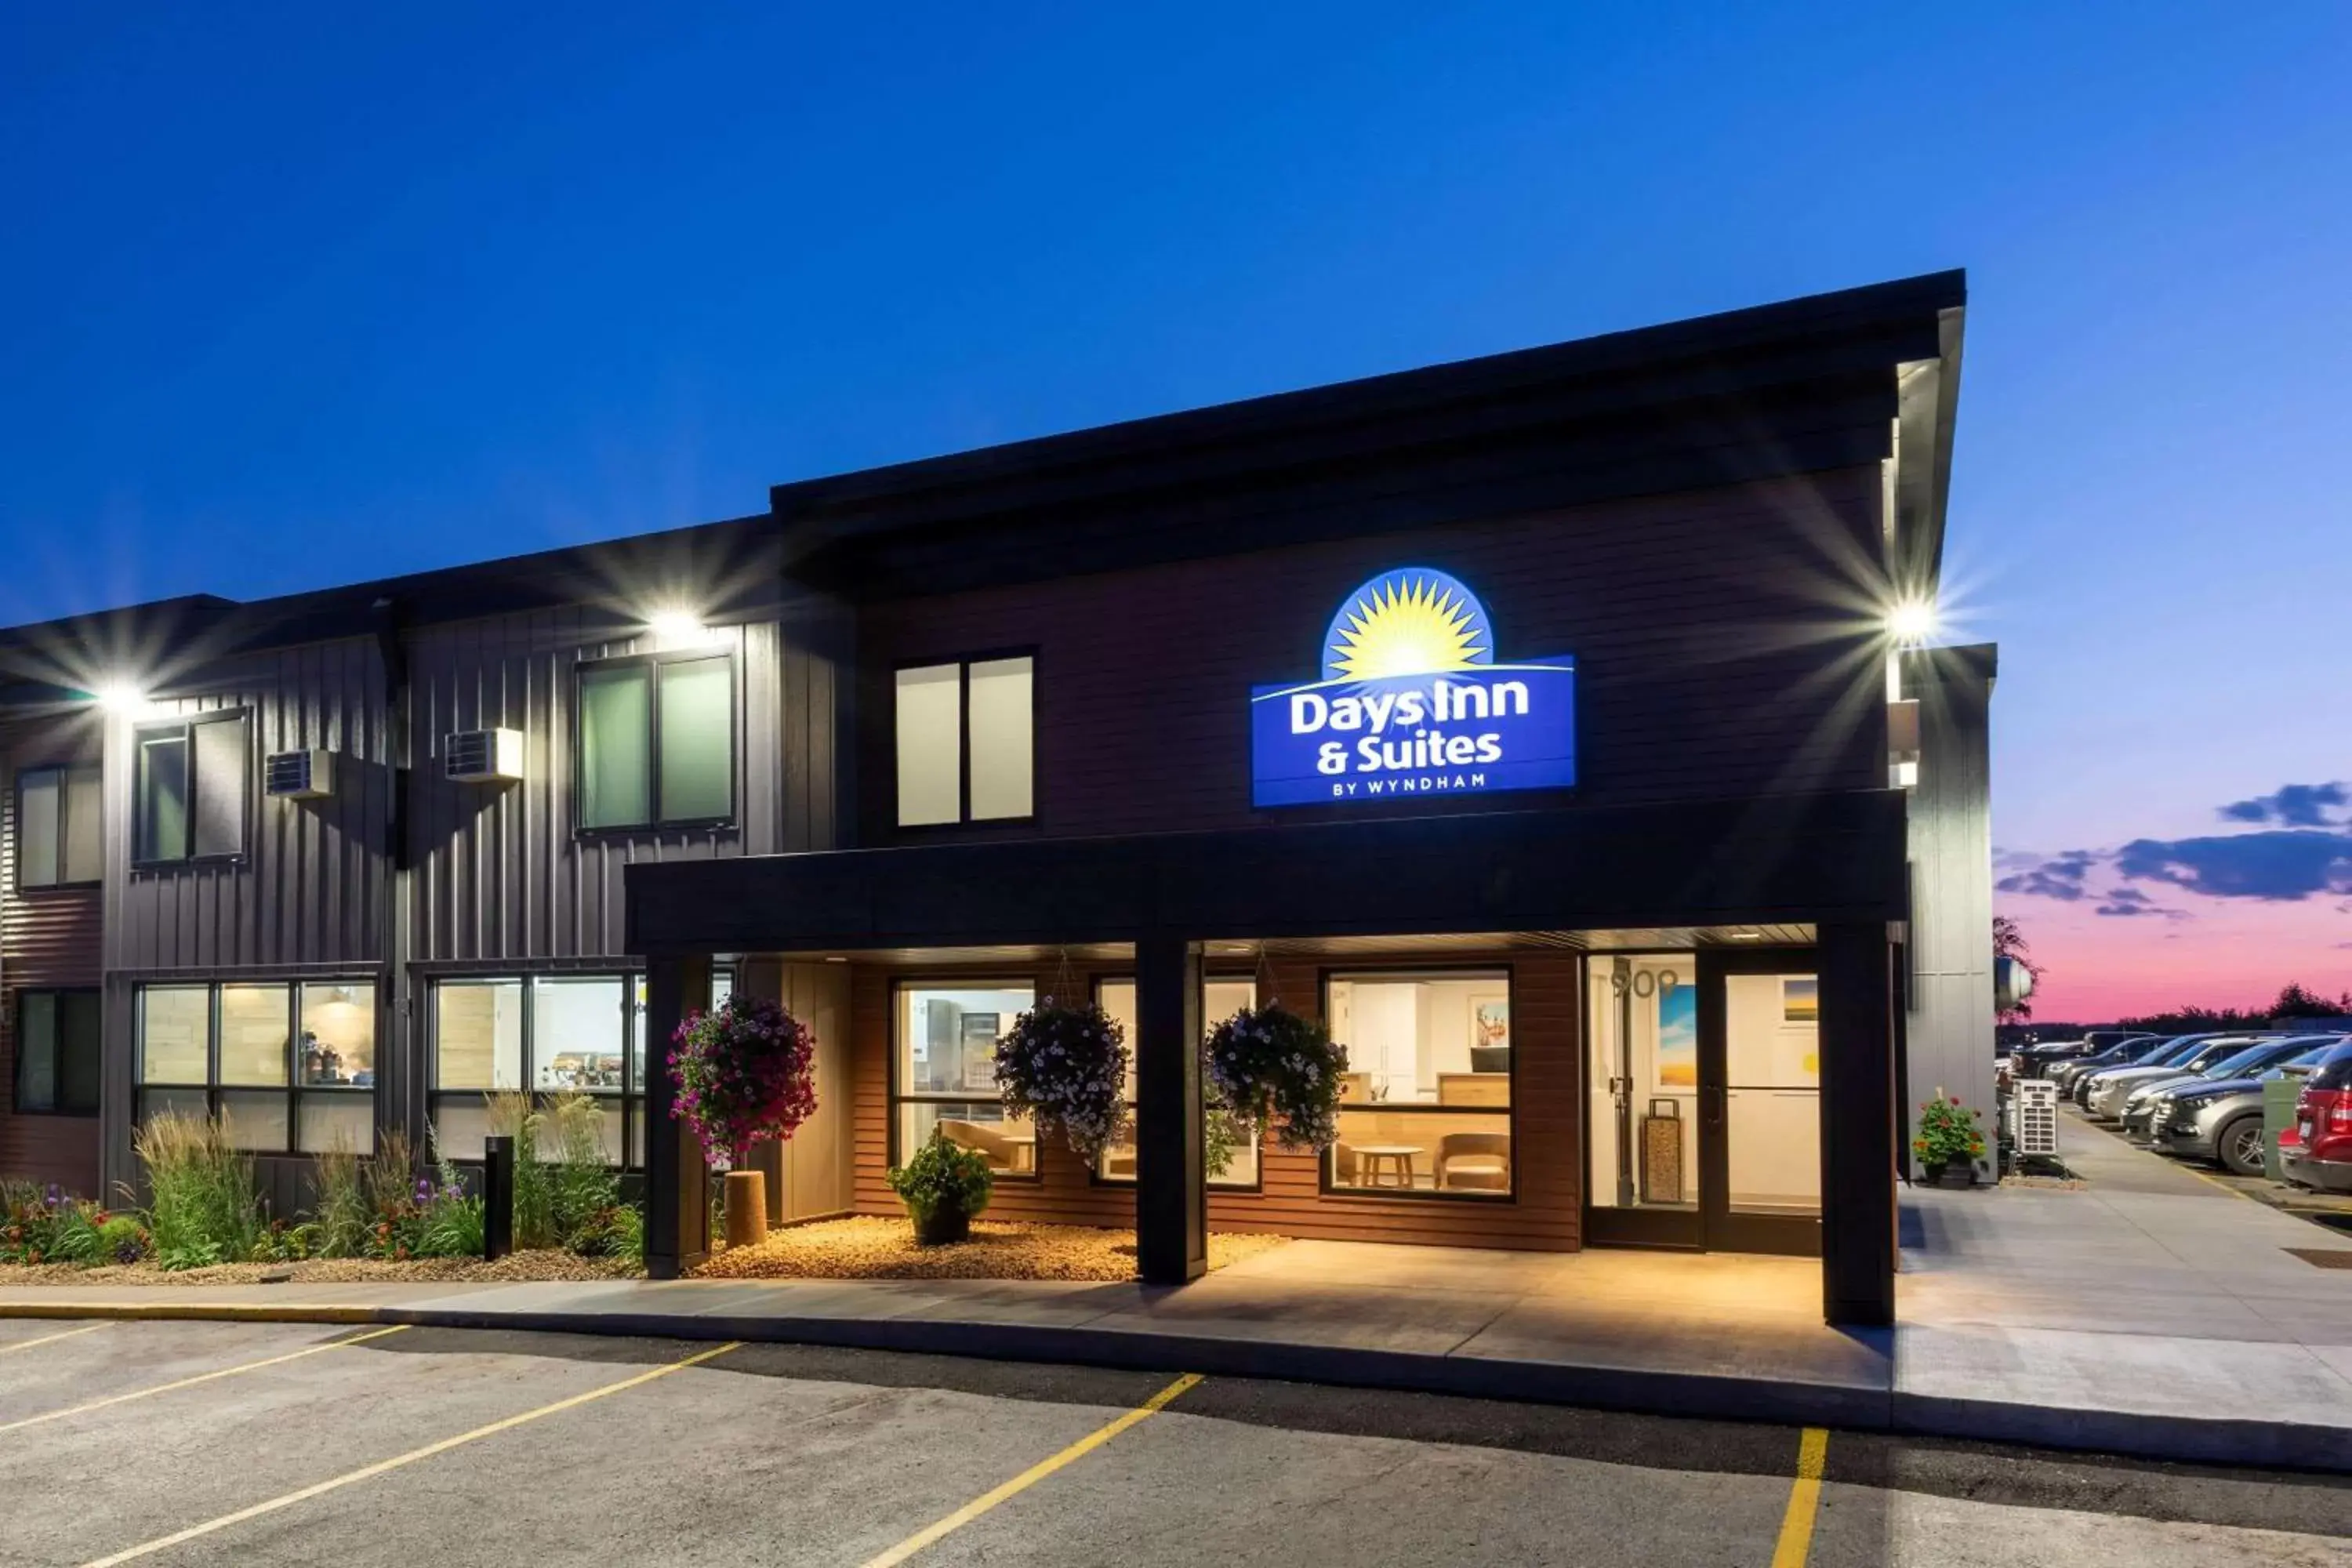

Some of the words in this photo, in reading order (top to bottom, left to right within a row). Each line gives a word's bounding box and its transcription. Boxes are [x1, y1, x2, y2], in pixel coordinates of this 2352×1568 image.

[1291, 693, 1423, 734] Days
[1434, 680, 1529, 722] Inn
[1317, 742, 1348, 775] &
[1357, 729, 1502, 772] Suites
[1334, 782, 1356, 796] BY
[1368, 774, 1485, 793] WYNDHAM
